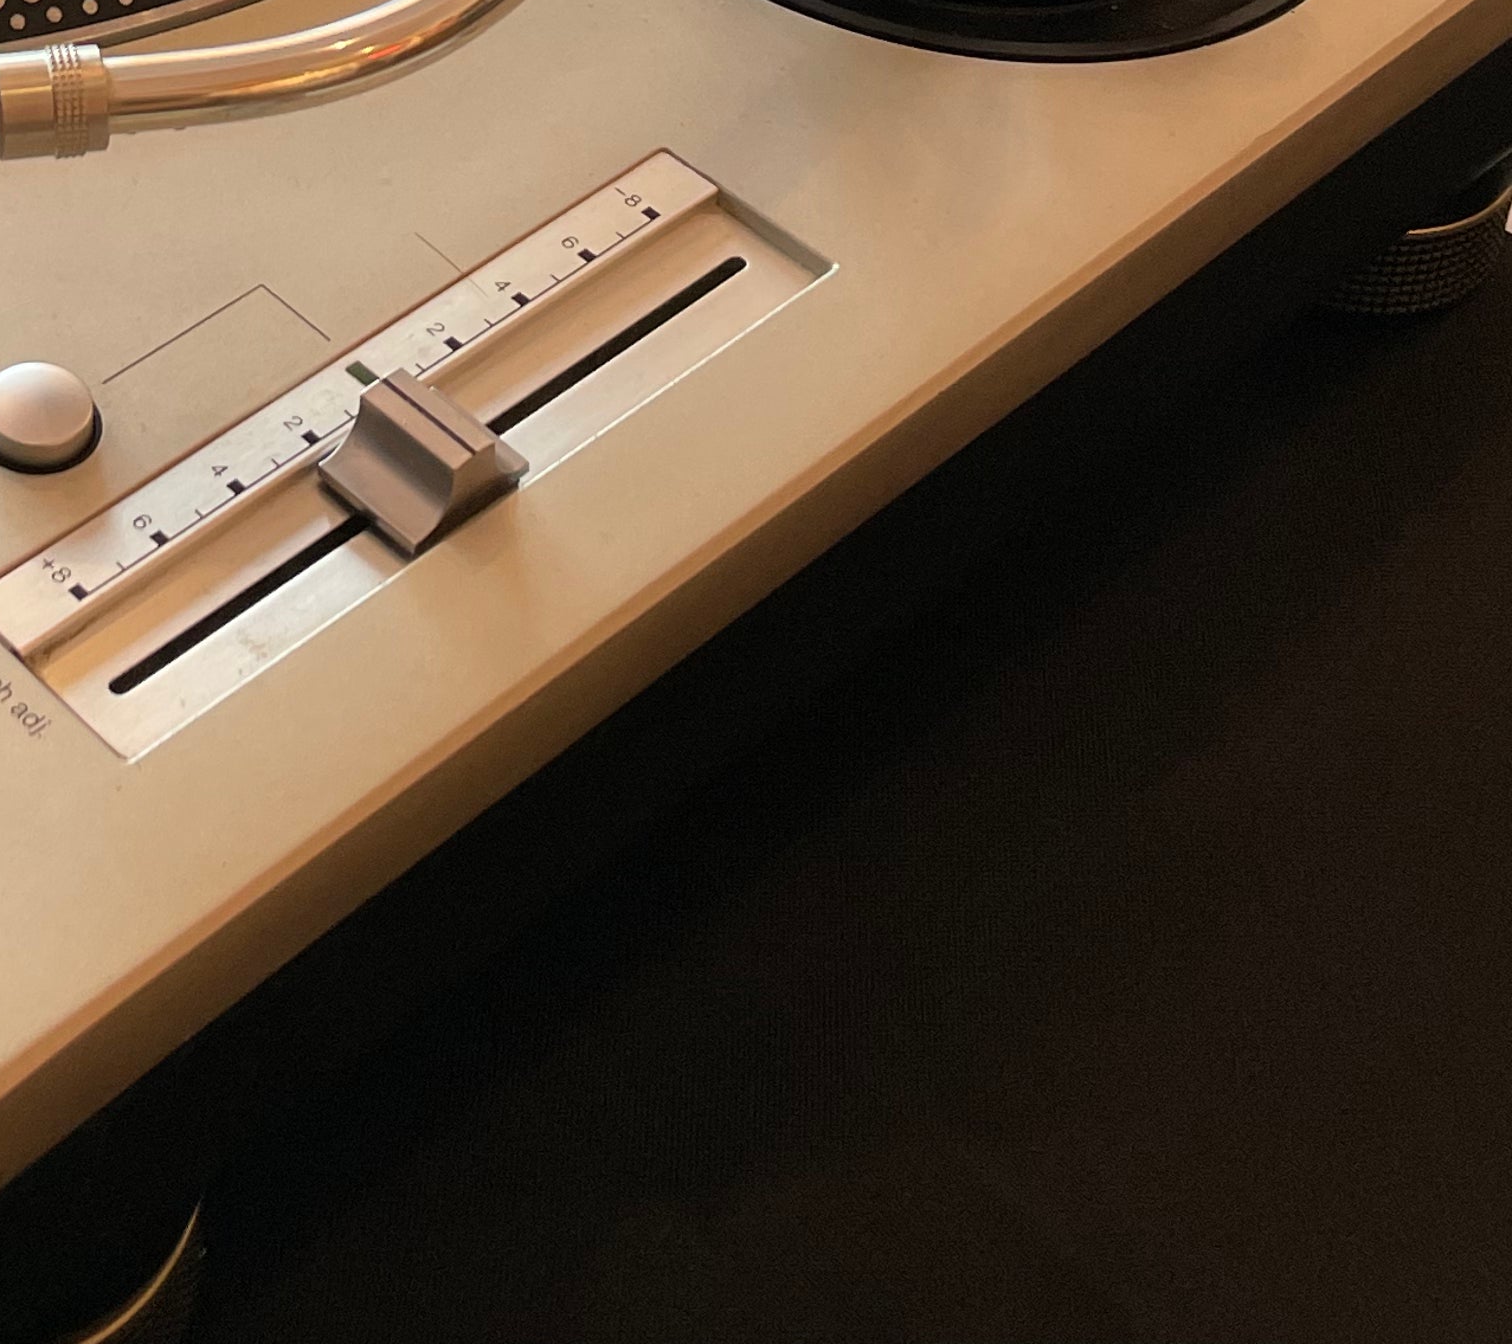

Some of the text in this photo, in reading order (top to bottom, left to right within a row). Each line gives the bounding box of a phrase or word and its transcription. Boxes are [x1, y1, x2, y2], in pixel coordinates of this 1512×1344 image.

[560, 235, 579, 251] 6
[493, 278, 511, 293] 4
[425, 321, 446, 337] 2
[283, 413, 304, 432] 2
[210, 463, 229, 479] 4
[134, 513, 153, 531] 6
